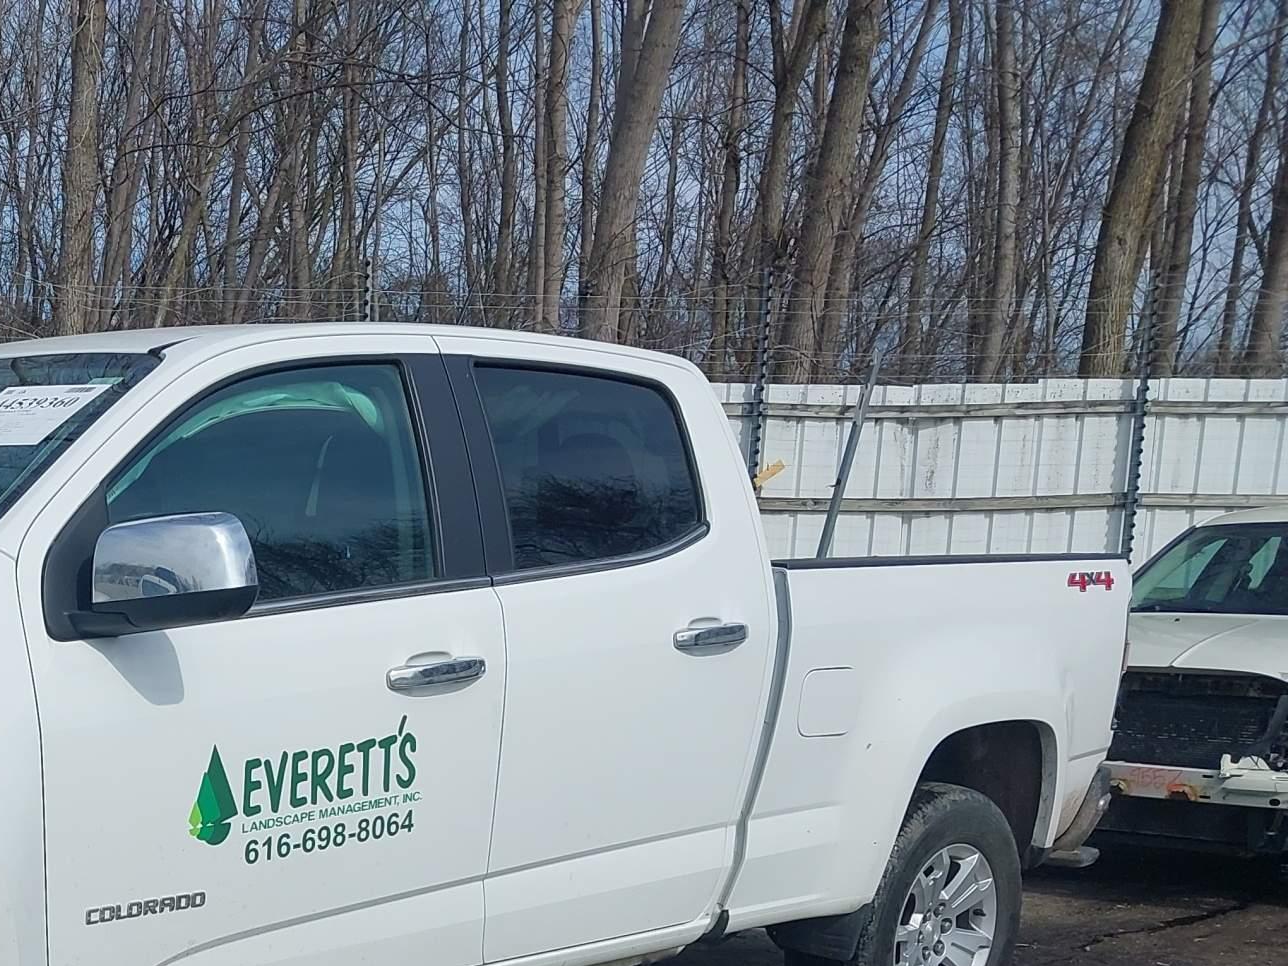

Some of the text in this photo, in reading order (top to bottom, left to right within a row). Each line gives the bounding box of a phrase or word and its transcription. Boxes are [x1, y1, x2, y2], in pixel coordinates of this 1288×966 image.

[241, 714, 417, 818] EVERETT'S
[241, 791, 424, 834] LANDSCAPE MANAGEMENT, INC.
[244, 809, 415, 865] 616-698-8064
[84, 891, 207, 926] COLORADO
